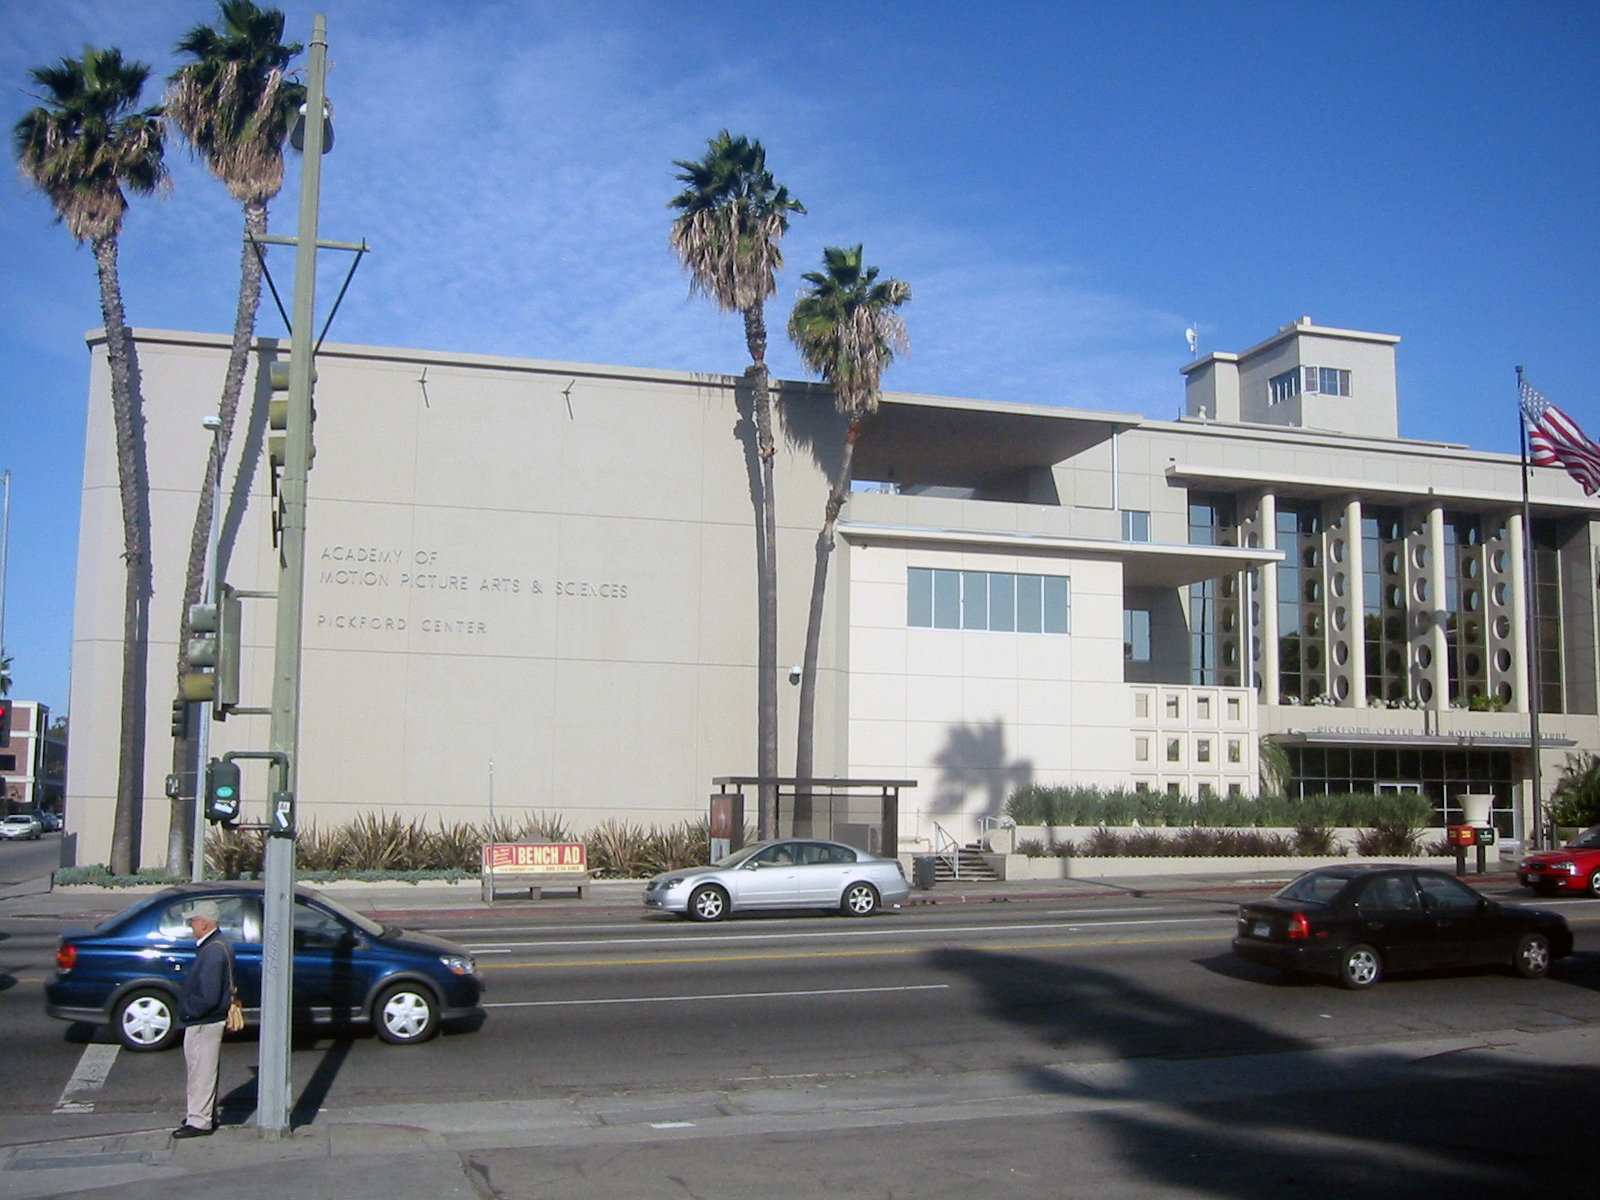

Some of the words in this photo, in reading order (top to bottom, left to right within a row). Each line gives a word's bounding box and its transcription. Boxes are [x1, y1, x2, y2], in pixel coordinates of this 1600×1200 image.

[320, 546, 403, 563] ACADEMY
[414, 550, 438, 565] OF
[319, 570, 389, 586] MOTION
[399, 573, 468, 590] PICTURE
[479, 578, 521, 593] ARTS
[532, 579, 543, 594] &
[555, 581, 628, 598] SCIENCES
[317, 615, 407, 631] PICKFORD
[421, 619, 486, 634] CENTER
[518, 847, 559, 865] BENCH
[563, 847, 580, 864] AD
